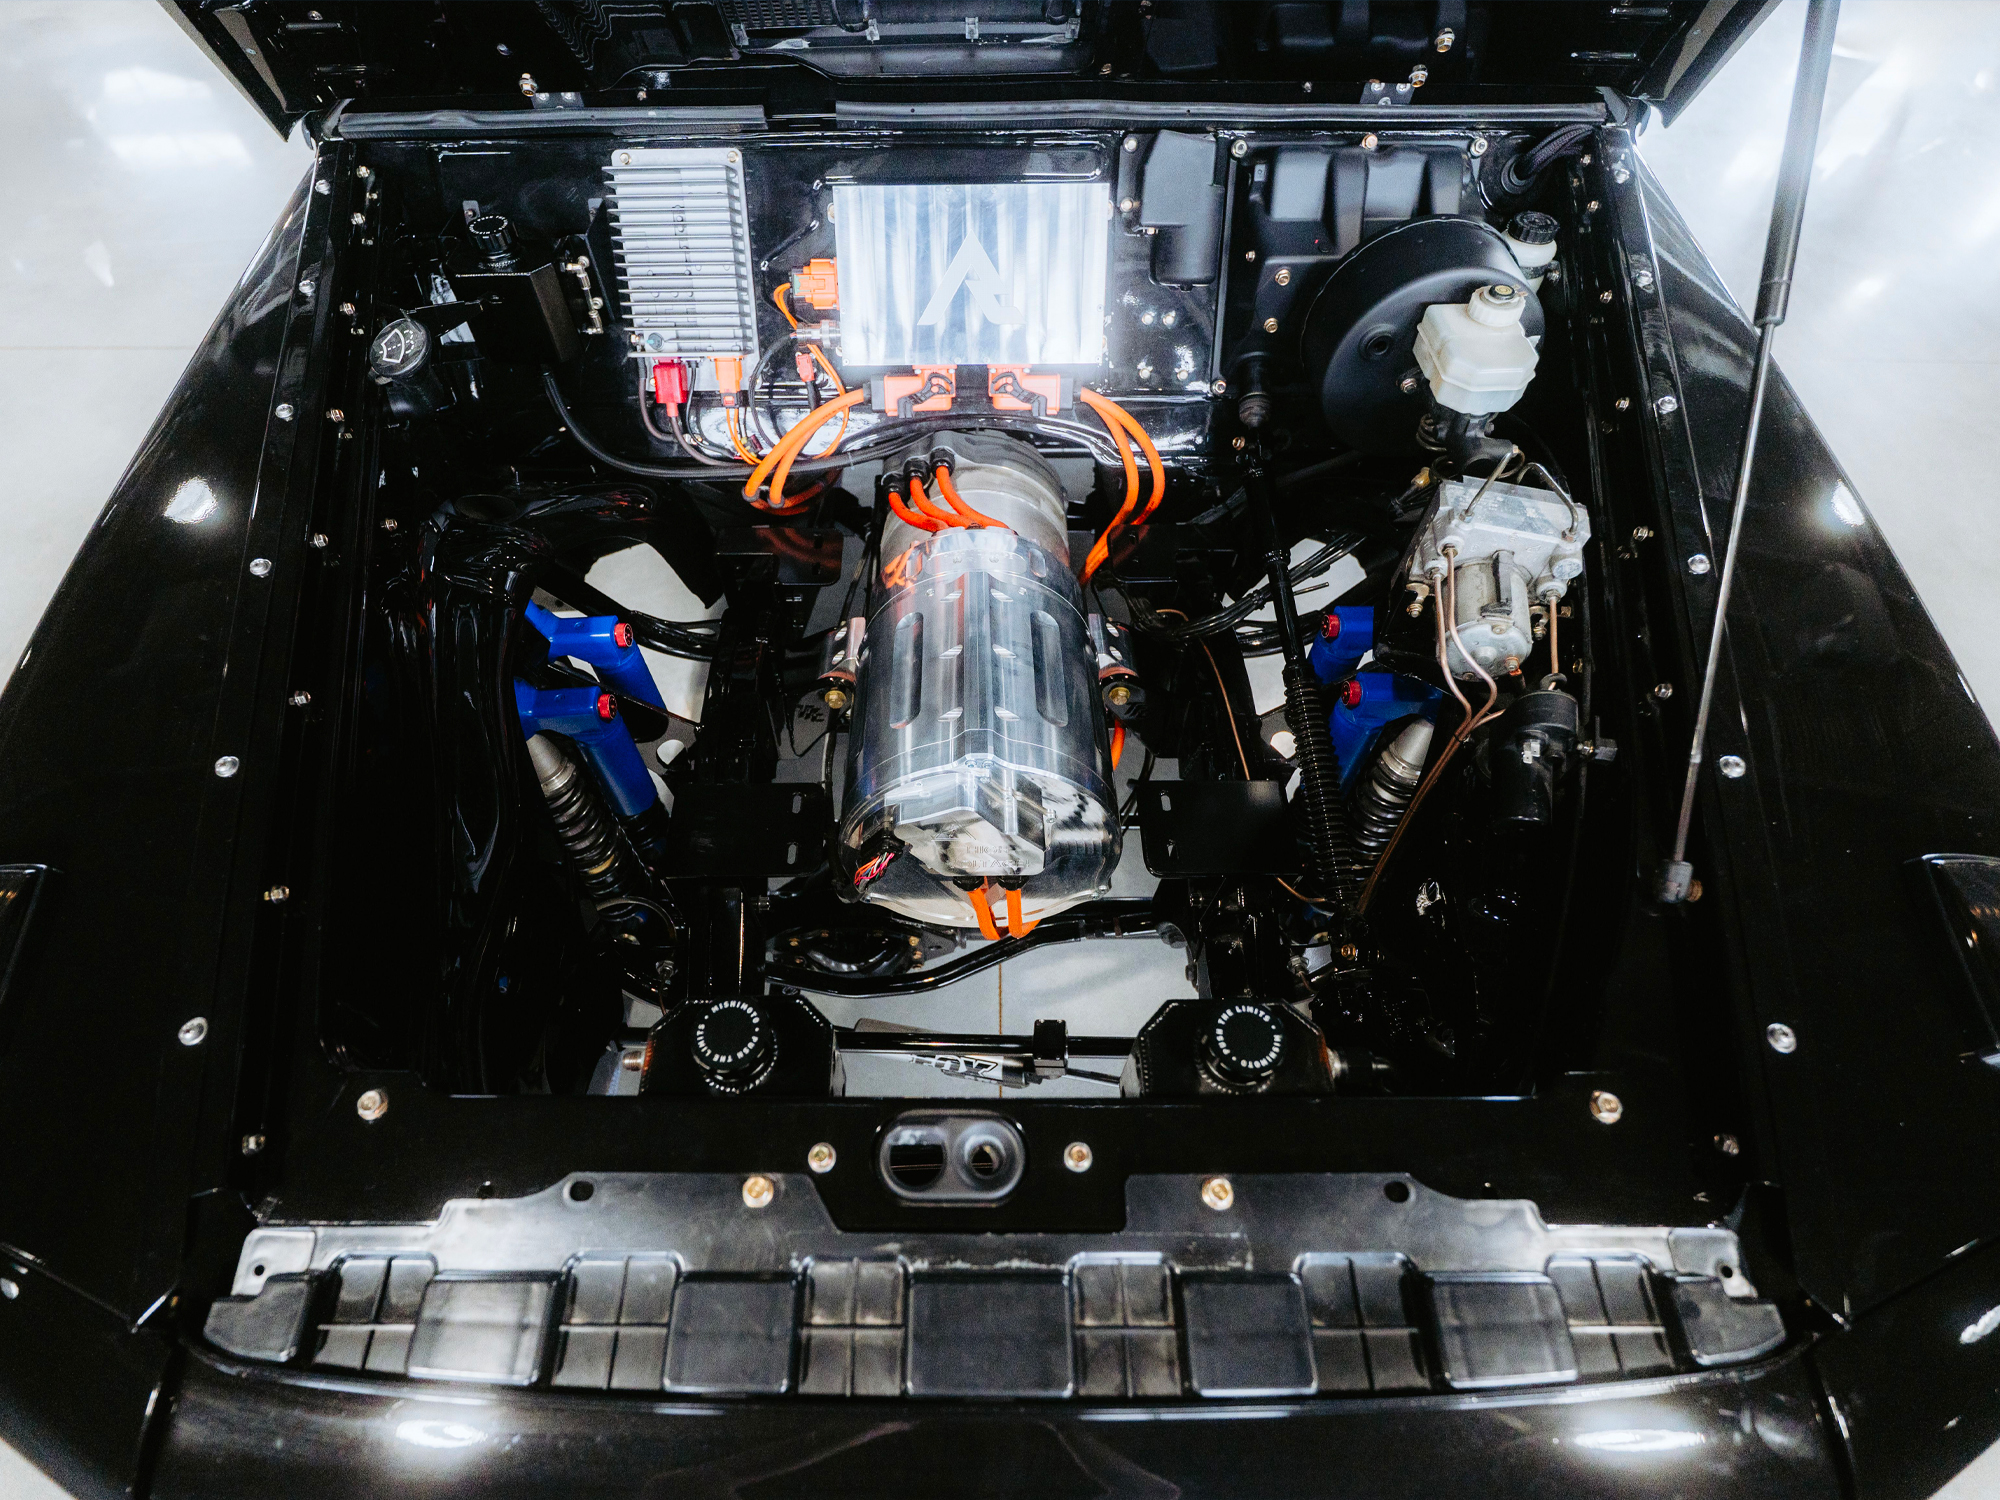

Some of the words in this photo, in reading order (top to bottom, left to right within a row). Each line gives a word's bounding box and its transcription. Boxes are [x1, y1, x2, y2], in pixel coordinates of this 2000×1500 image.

[711, 1000, 760, 1024] MISHIMOTO
[1217, 1008, 1234, 1025] THE
[1235, 1004, 1271, 1022] LIMITS
[696, 1023, 712, 1057] LIMITS
[736, 1035, 759, 1059] PUSH
[1215, 1028, 1231, 1055] PUSH
[1240, 1034, 1282, 1069] MISHIMOTO
[712, 1053, 733, 1063] THE
